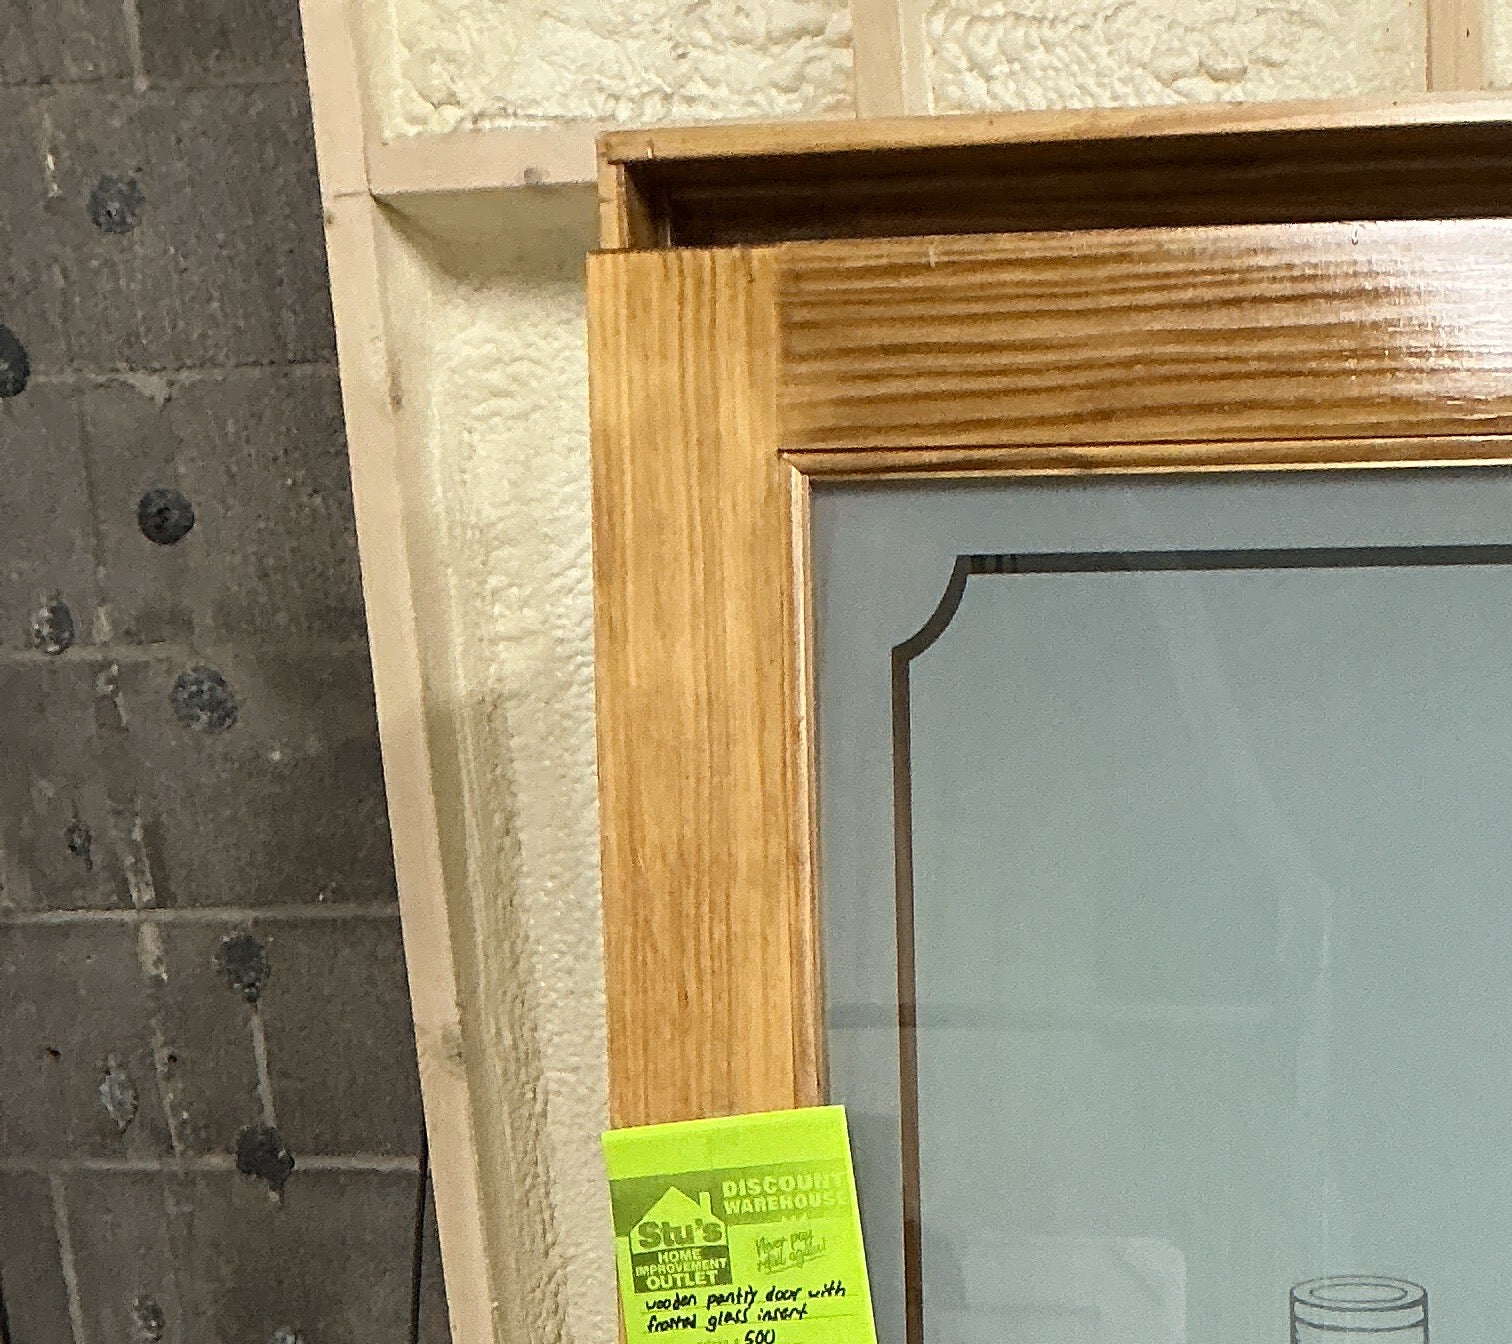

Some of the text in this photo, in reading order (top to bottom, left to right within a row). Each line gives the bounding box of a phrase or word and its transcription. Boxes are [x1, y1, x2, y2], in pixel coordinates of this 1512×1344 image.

[722, 1171, 843, 1198] DISCOUNT
[638, 1218, 723, 1249] Stu's
[657, 1248, 702, 1264] HOME
[635, 1257, 728, 1277] IMPROVEMENT
[645, 1269, 719, 1290] OUTLET
[765, 1285, 802, 1302] door
[808, 1280, 846, 1299] with
[757, 1303, 808, 1322] insert
